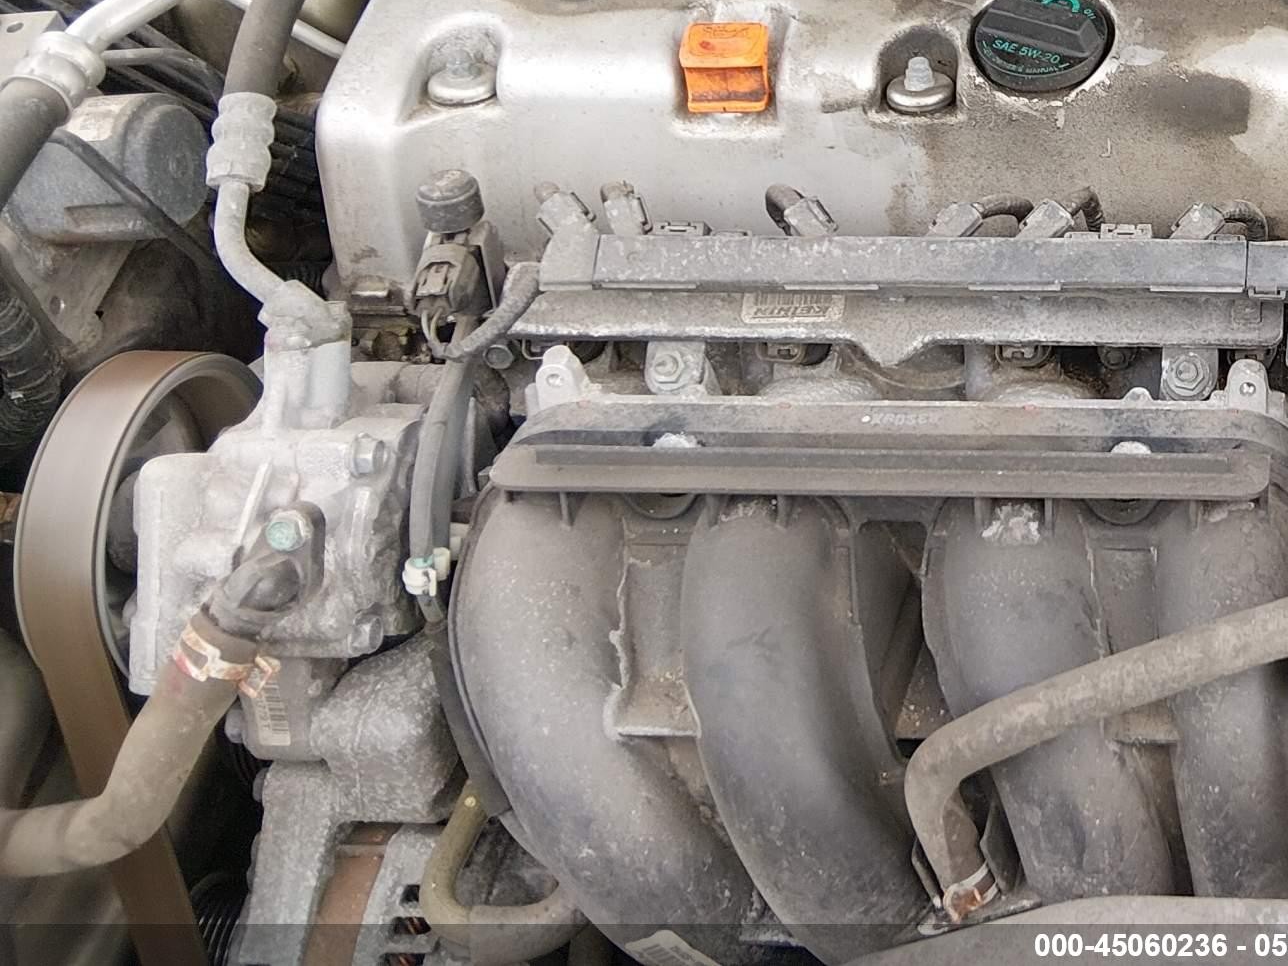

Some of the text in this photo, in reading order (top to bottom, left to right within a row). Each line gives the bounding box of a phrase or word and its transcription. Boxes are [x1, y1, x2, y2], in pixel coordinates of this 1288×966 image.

[992, 39, 1061, 64] SAE 5W-20
[754, 305, 830, 316] KEIHIN
